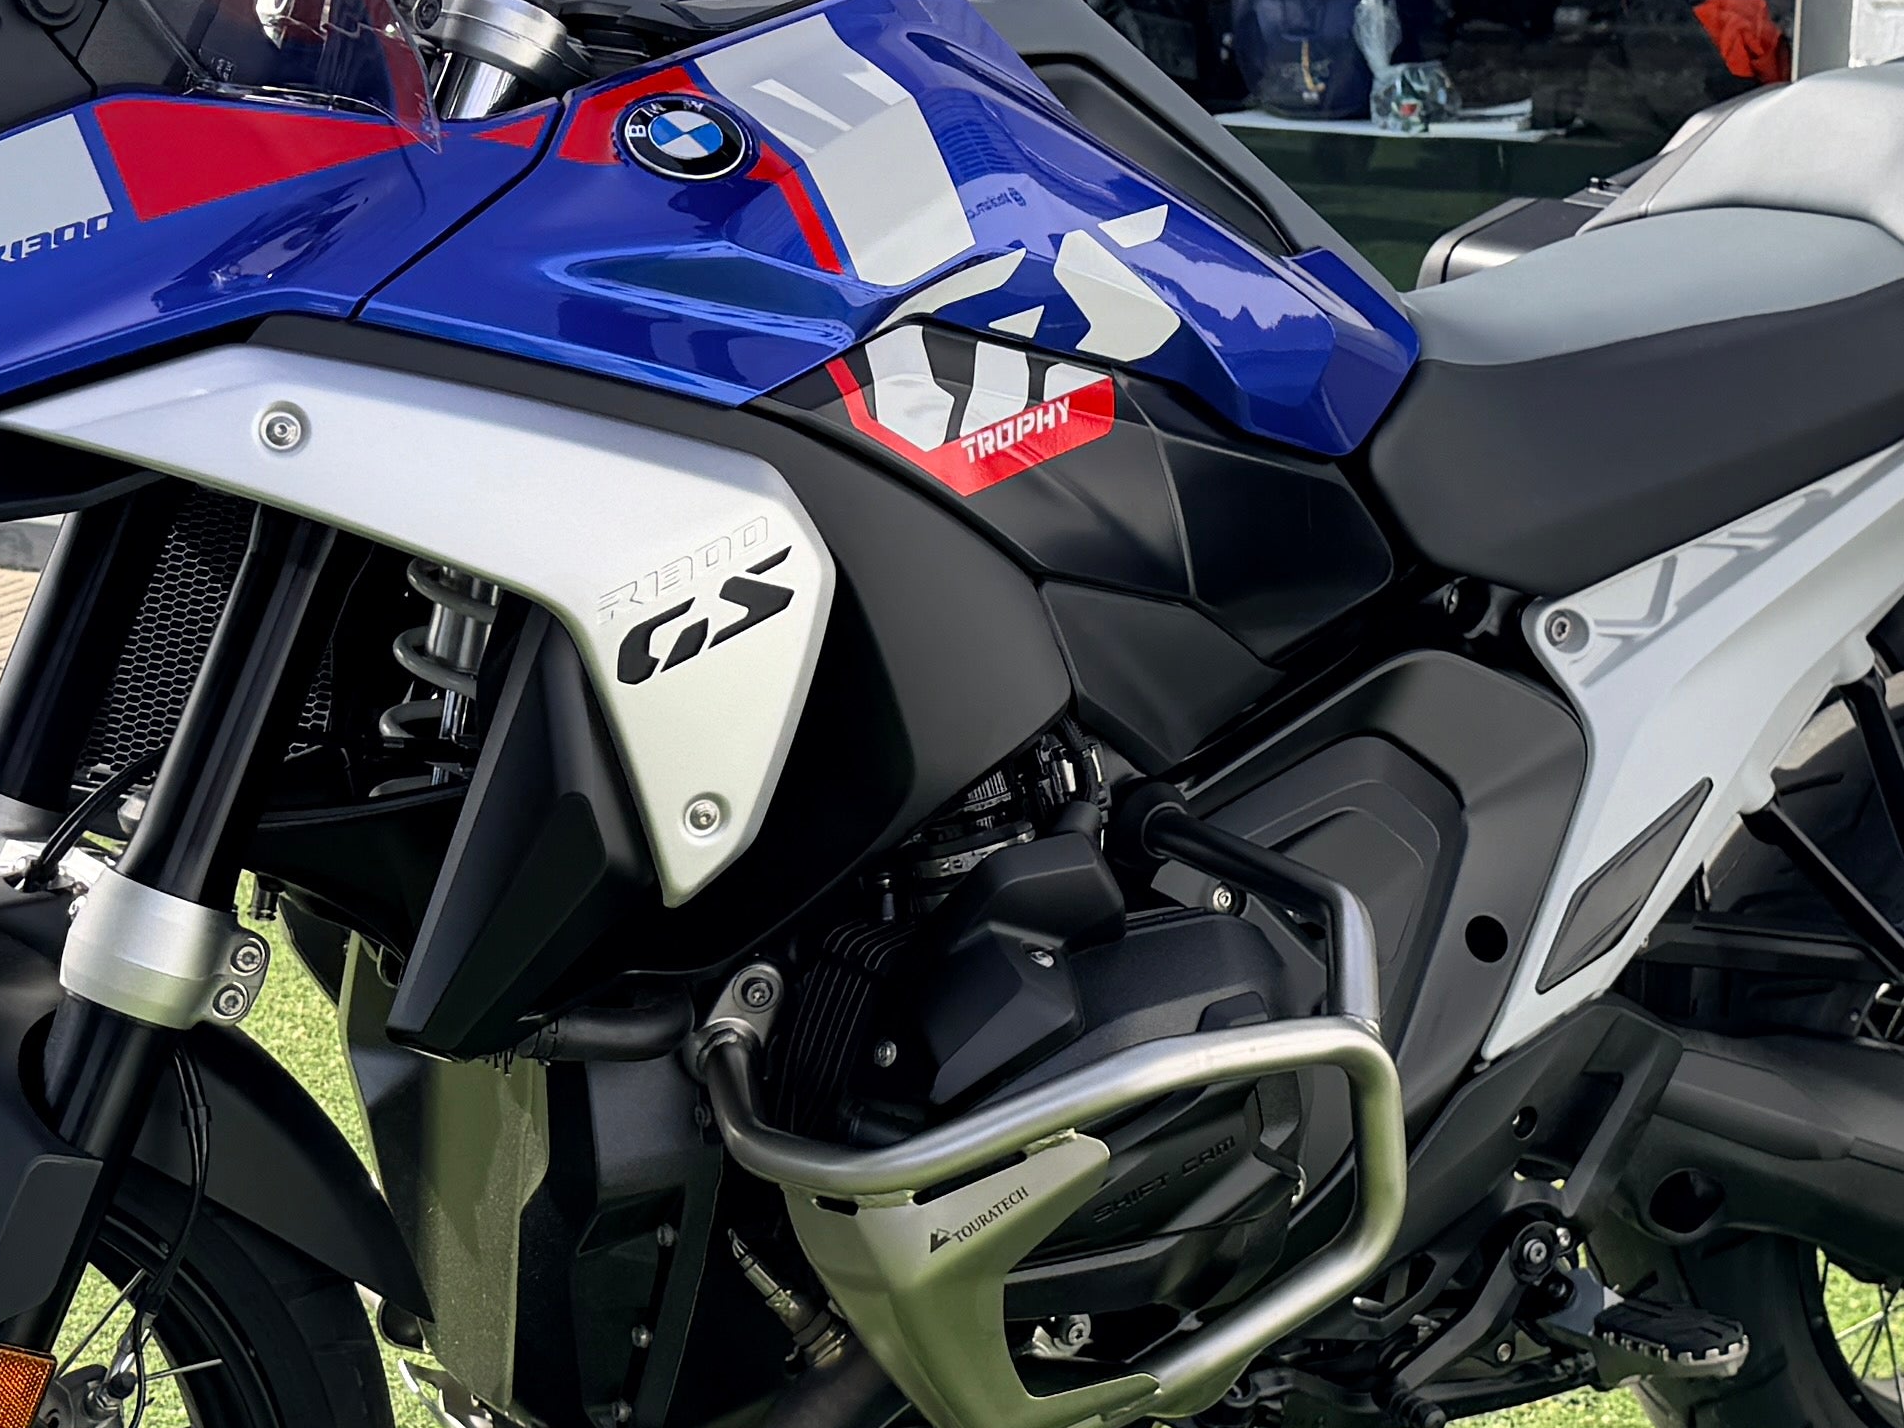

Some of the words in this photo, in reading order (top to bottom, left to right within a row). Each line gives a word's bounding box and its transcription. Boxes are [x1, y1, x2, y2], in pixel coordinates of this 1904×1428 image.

[960, 395, 1071, 464] TROPHY
[596, 515, 769, 627] R1300
[617, 544, 795, 685] GS
[952, 1185, 1030, 1243] TOURATECH
[1092, 1173, 1170, 1223] SHIFT
[1182, 1135, 1237, 1178] CAM
